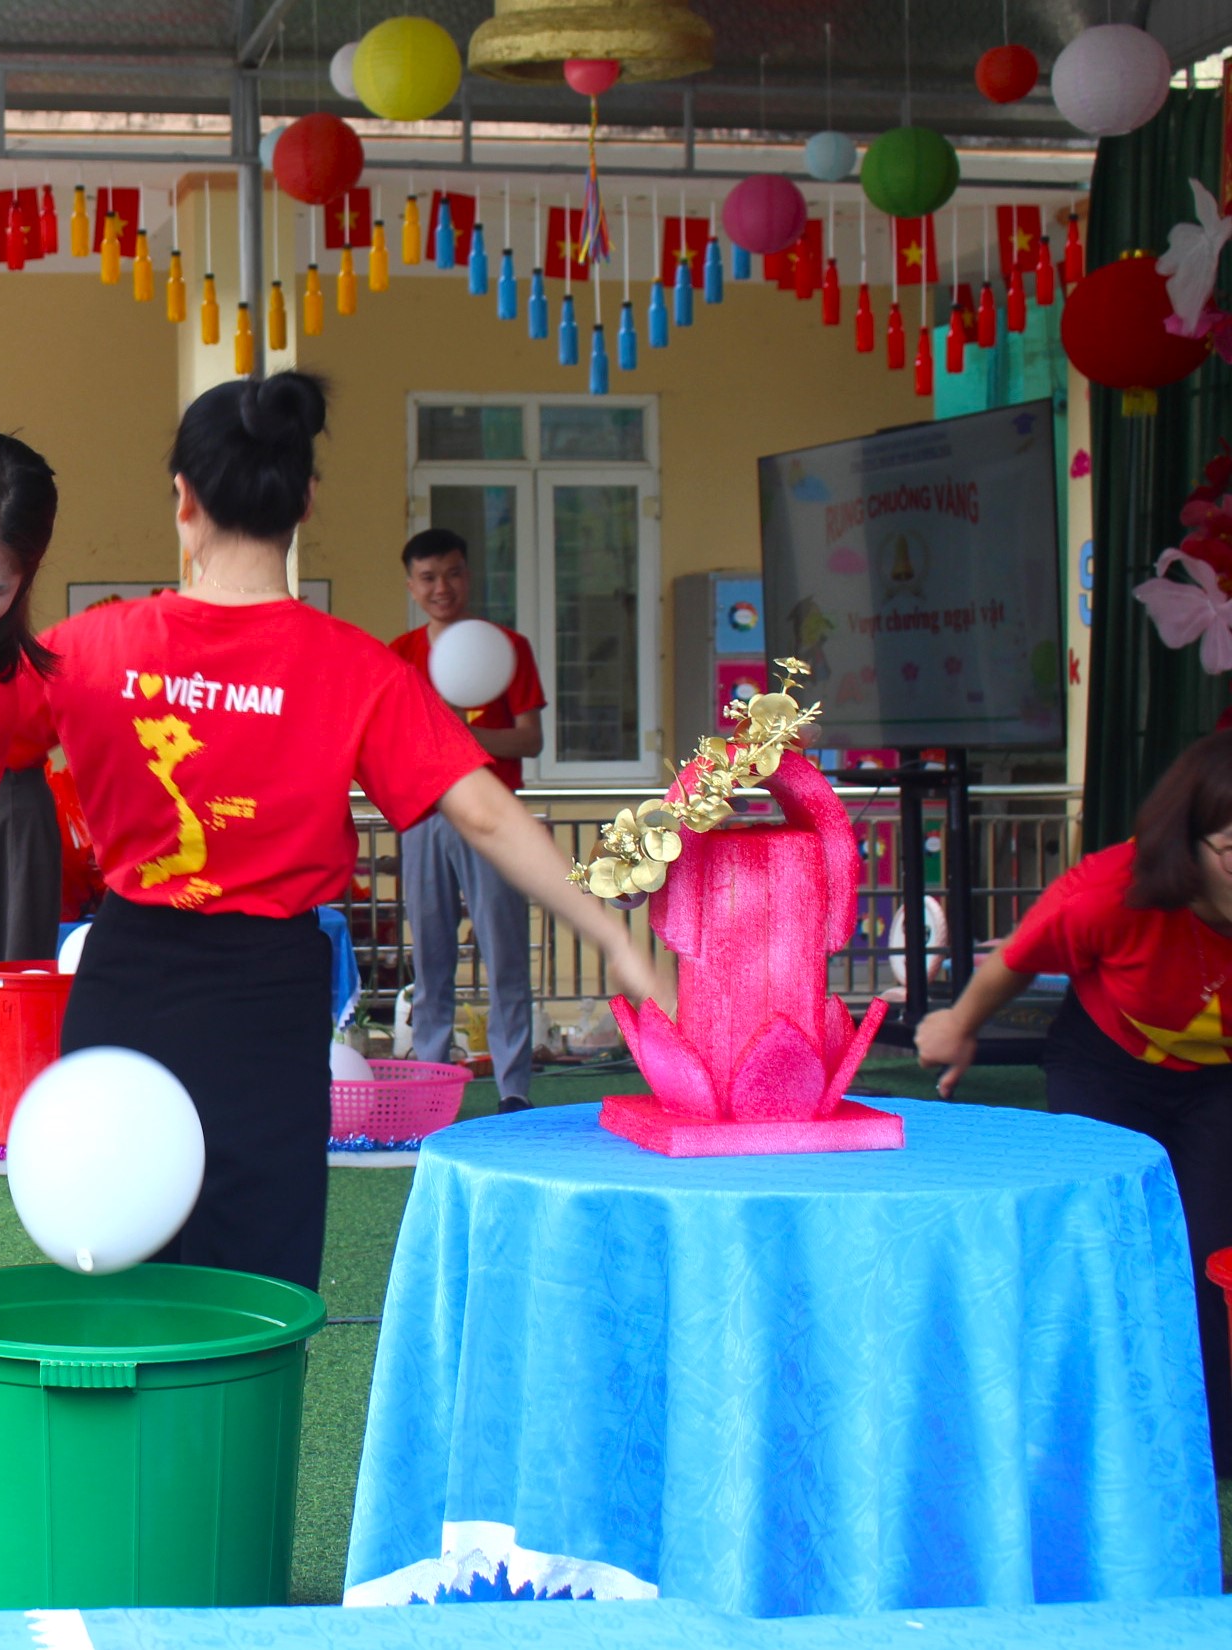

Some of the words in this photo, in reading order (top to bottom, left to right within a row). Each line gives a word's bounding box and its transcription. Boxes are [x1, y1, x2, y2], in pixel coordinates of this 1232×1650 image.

[868, 484, 932, 519] CHUÔNG
[933, 475, 980, 525] VÀNG
[121, 669, 138, 699] I
[164, 671, 223, 714] VIỆT
[224, 683, 284, 716] NAM
